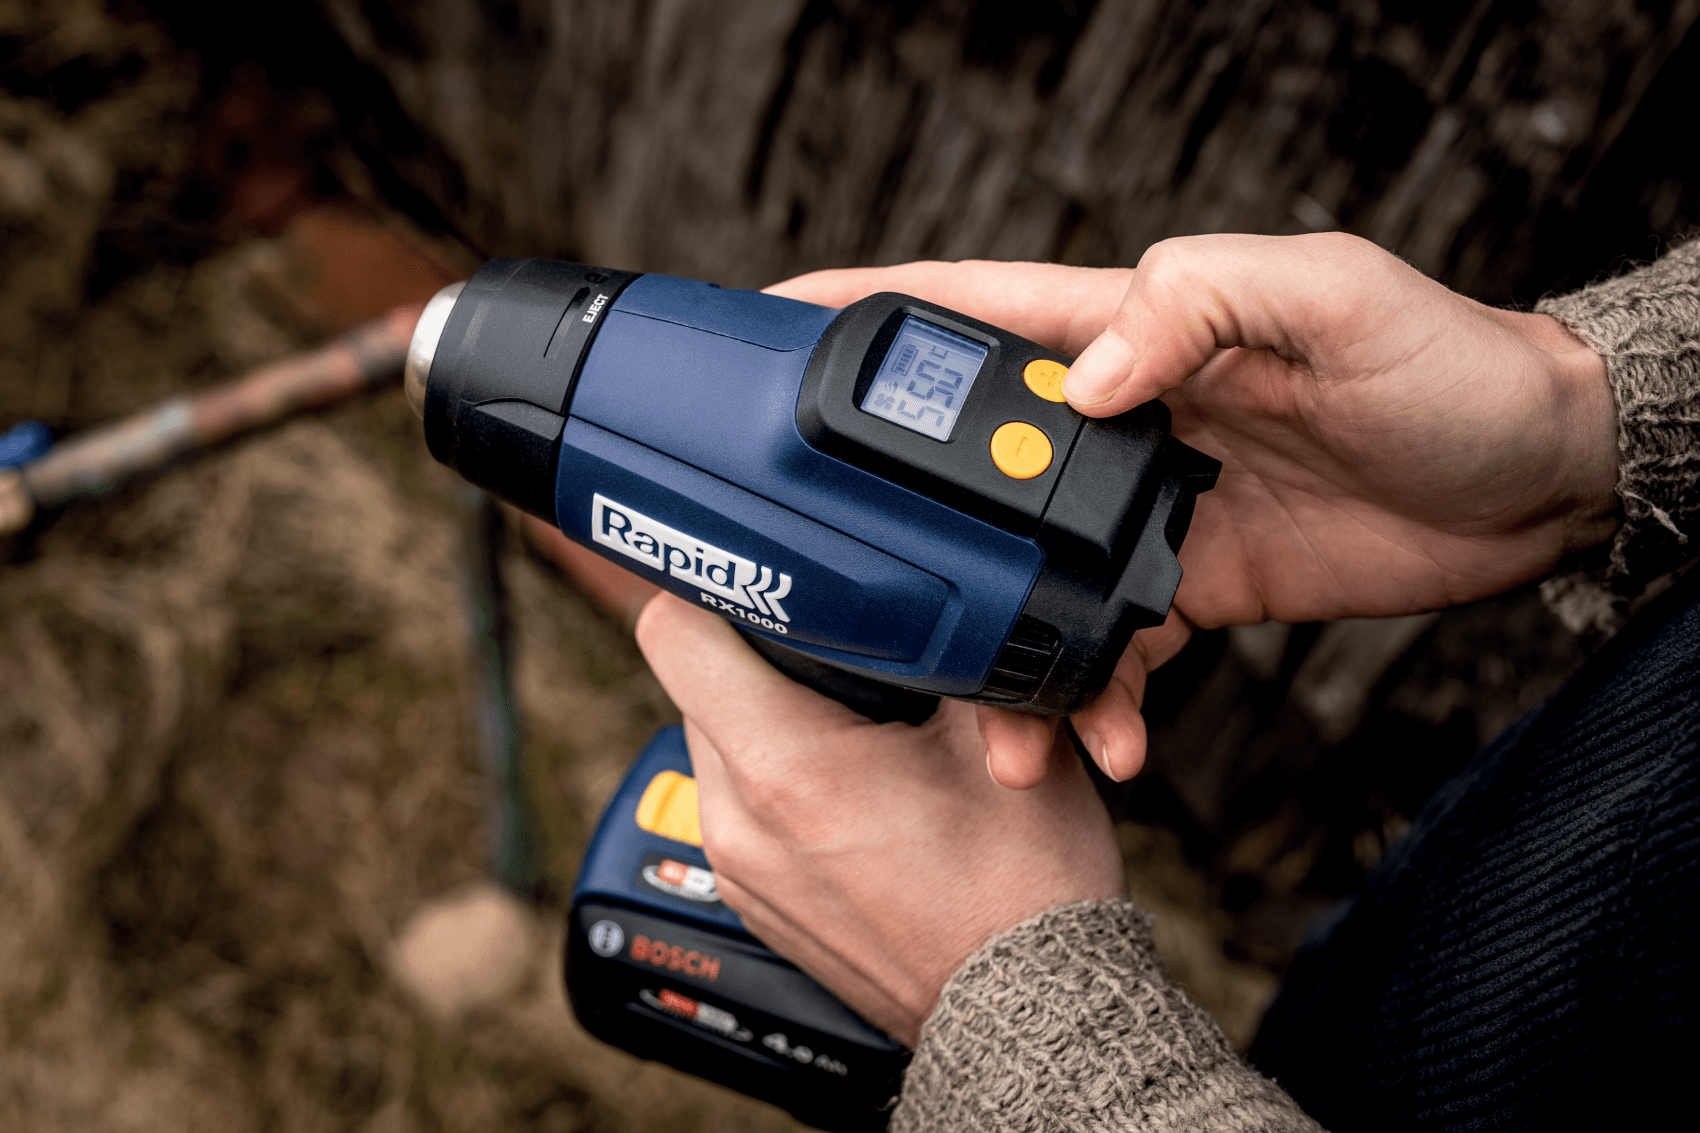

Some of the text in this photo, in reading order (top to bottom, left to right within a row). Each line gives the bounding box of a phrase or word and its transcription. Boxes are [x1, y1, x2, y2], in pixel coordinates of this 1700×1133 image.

[582, 293, 609, 324] EJECT
[599, 501, 740, 593] Rapid
[700, 591, 788, 635] RX1000
[630, 934, 722, 982] BOSCH
